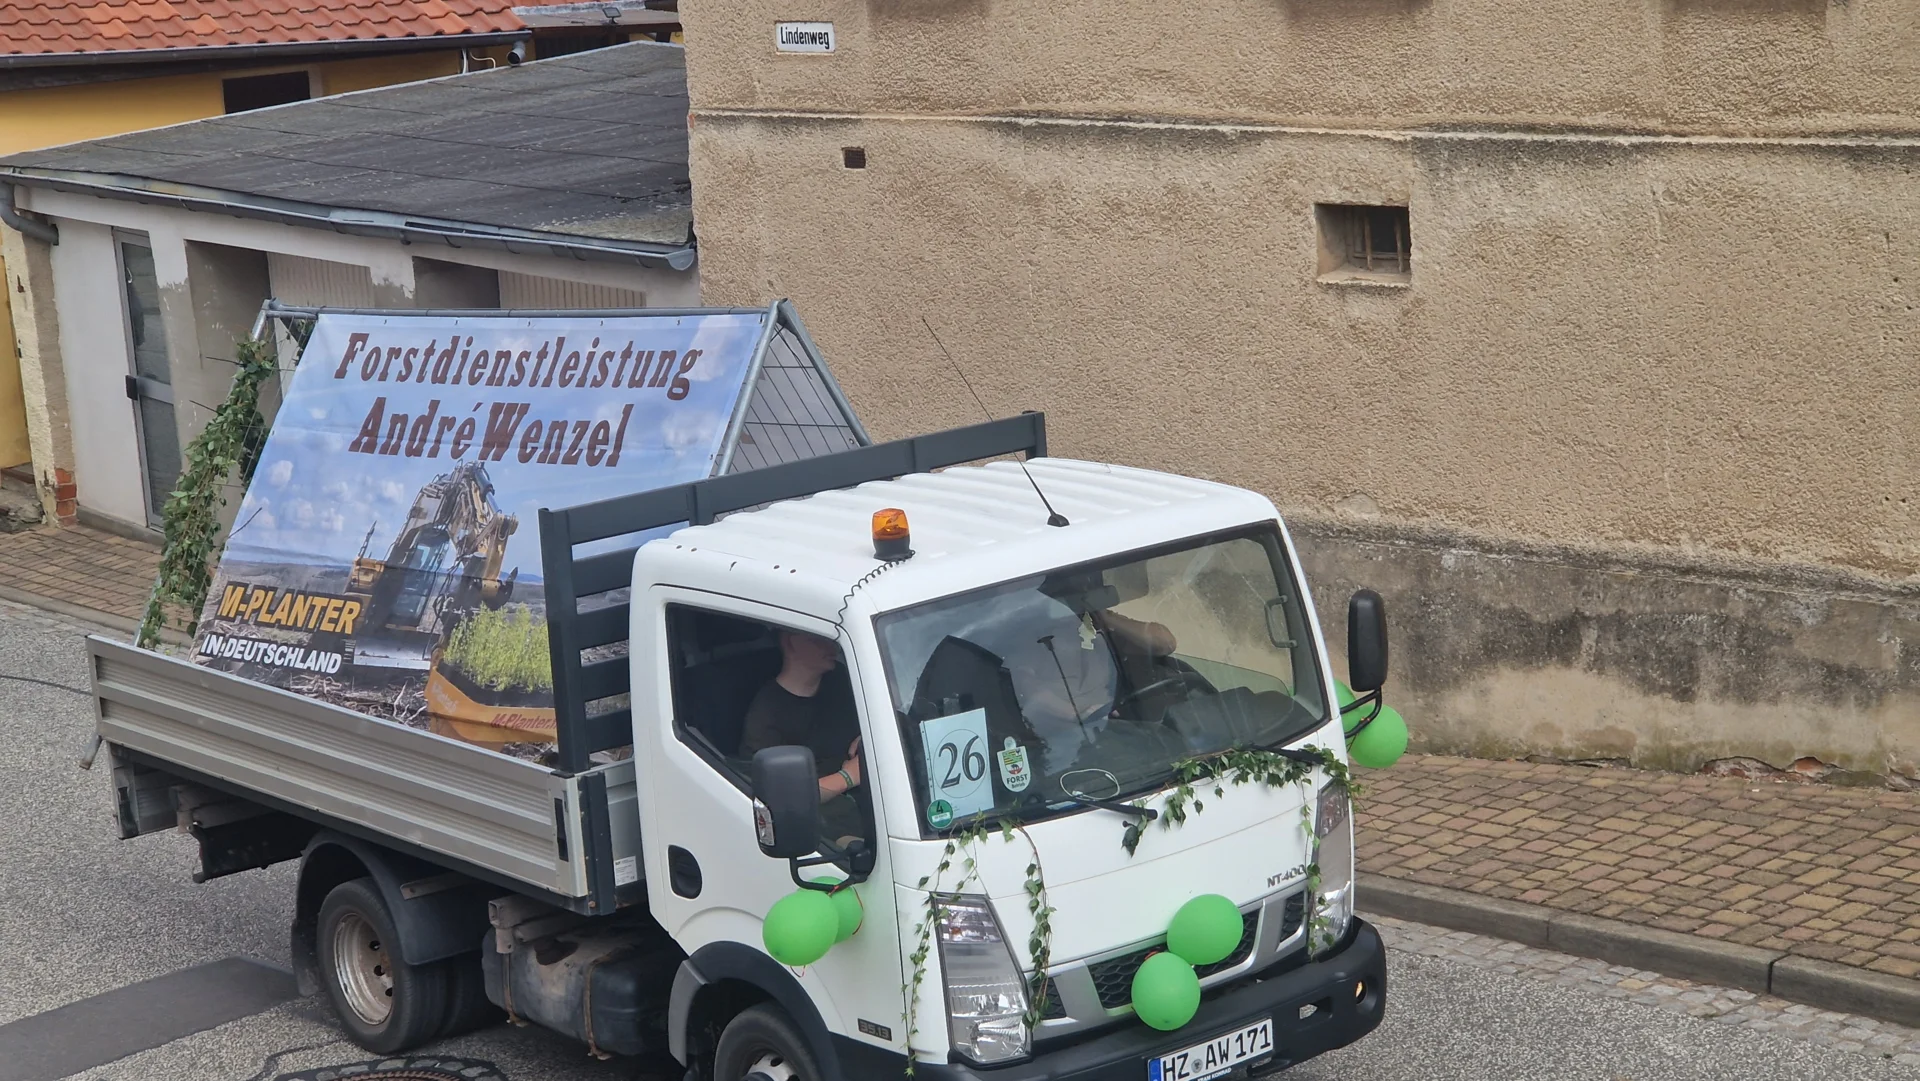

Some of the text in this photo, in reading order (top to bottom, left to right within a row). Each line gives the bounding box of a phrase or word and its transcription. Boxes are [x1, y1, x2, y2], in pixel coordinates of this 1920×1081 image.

[780, 26, 830, 50] Lindenweg
[334, 332, 703, 400] Forstdienstleistung
[348, 396, 634, 467] André Wenzel
[217, 585, 361, 635] M-PLANTER
[223, 638, 342, 674] DEUTSCHLAND
[938, 735, 986, 789] 26
[1006, 773, 1028, 785] FORST
[936, 800, 944, 814] 4
[1162, 1024, 1271, 1081] HZ AW 171
